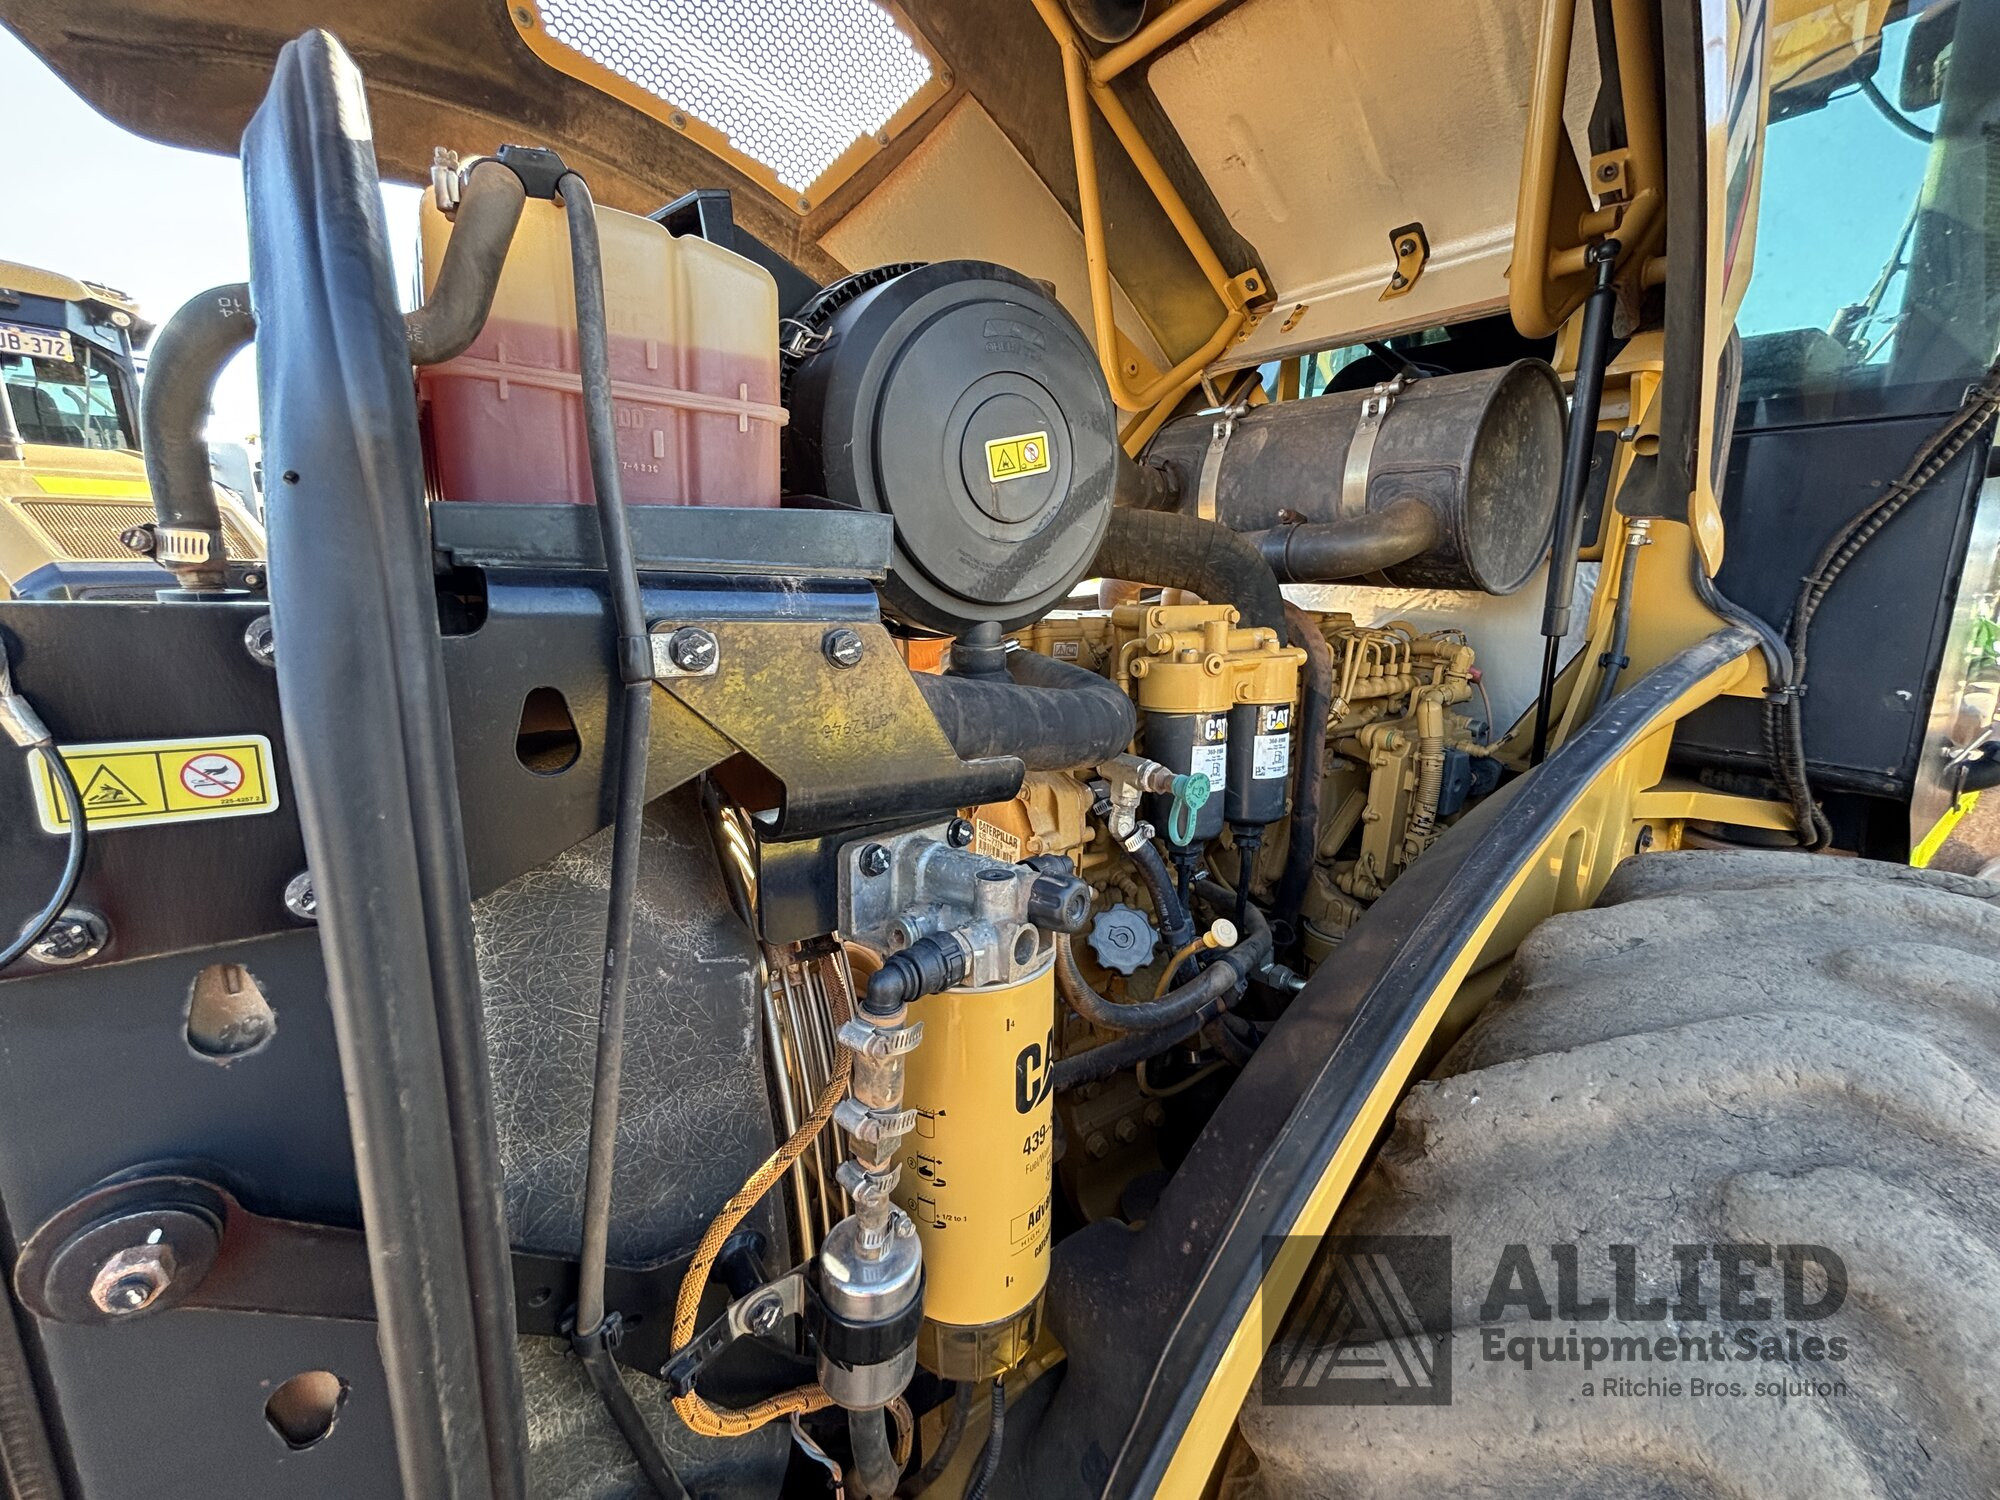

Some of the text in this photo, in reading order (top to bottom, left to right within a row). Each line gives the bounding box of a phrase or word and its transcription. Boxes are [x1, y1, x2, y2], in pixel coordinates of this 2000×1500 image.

[1205, 718, 1227, 741] CAT
[1267, 709, 1289, 731] CAT
[978, 820, 1018, 849] CATERPILLAR
[1015, 1023, 1053, 1115] CA
